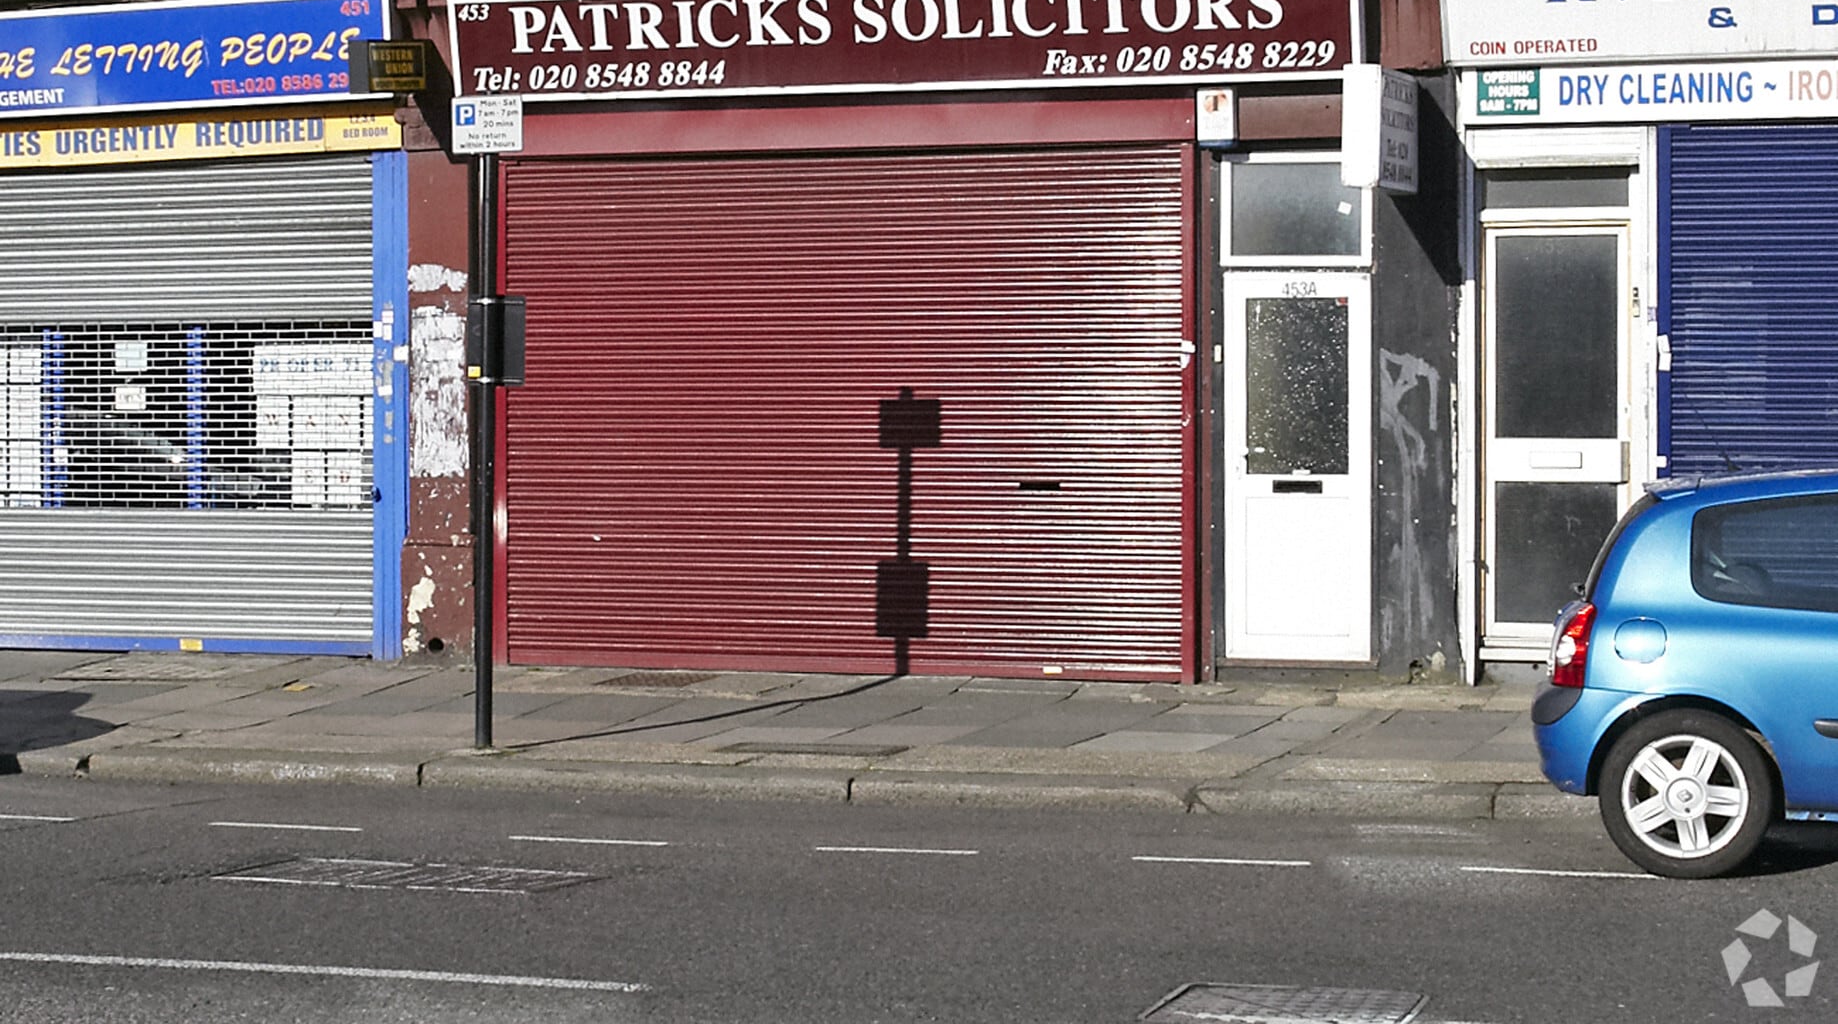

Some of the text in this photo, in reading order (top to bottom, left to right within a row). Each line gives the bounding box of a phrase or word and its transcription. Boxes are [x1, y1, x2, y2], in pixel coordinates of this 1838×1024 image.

[340, 0, 370, 16] 451
[458, 4, 490, 22] 453
[1708, 6, 1738, 28] &
[49, 39, 206, 77] LETTING
[220, 27, 361, 67] PEOPLE
[1470, 38, 1598, 56] COIN OPERATED
[1042, 40, 1336, 76] Fax: 020 8548 8229
[473, 59, 726, 92] Tel: 020 8548 8844
[1482, 70, 1536, 84] OPENING
[1488, 84, 1530, 98] HOURS
[1559, 75, 1610, 106] DRY
[1619, 71, 1754, 103] CLEANING
[55, 124, 178, 155] URGENTLY
[195, 117, 325, 148] REQUIRED
[343, 127, 389, 138] BED ROOM
[481, 132, 507, 140] return
[1282, 281, 1318, 297] 453A
